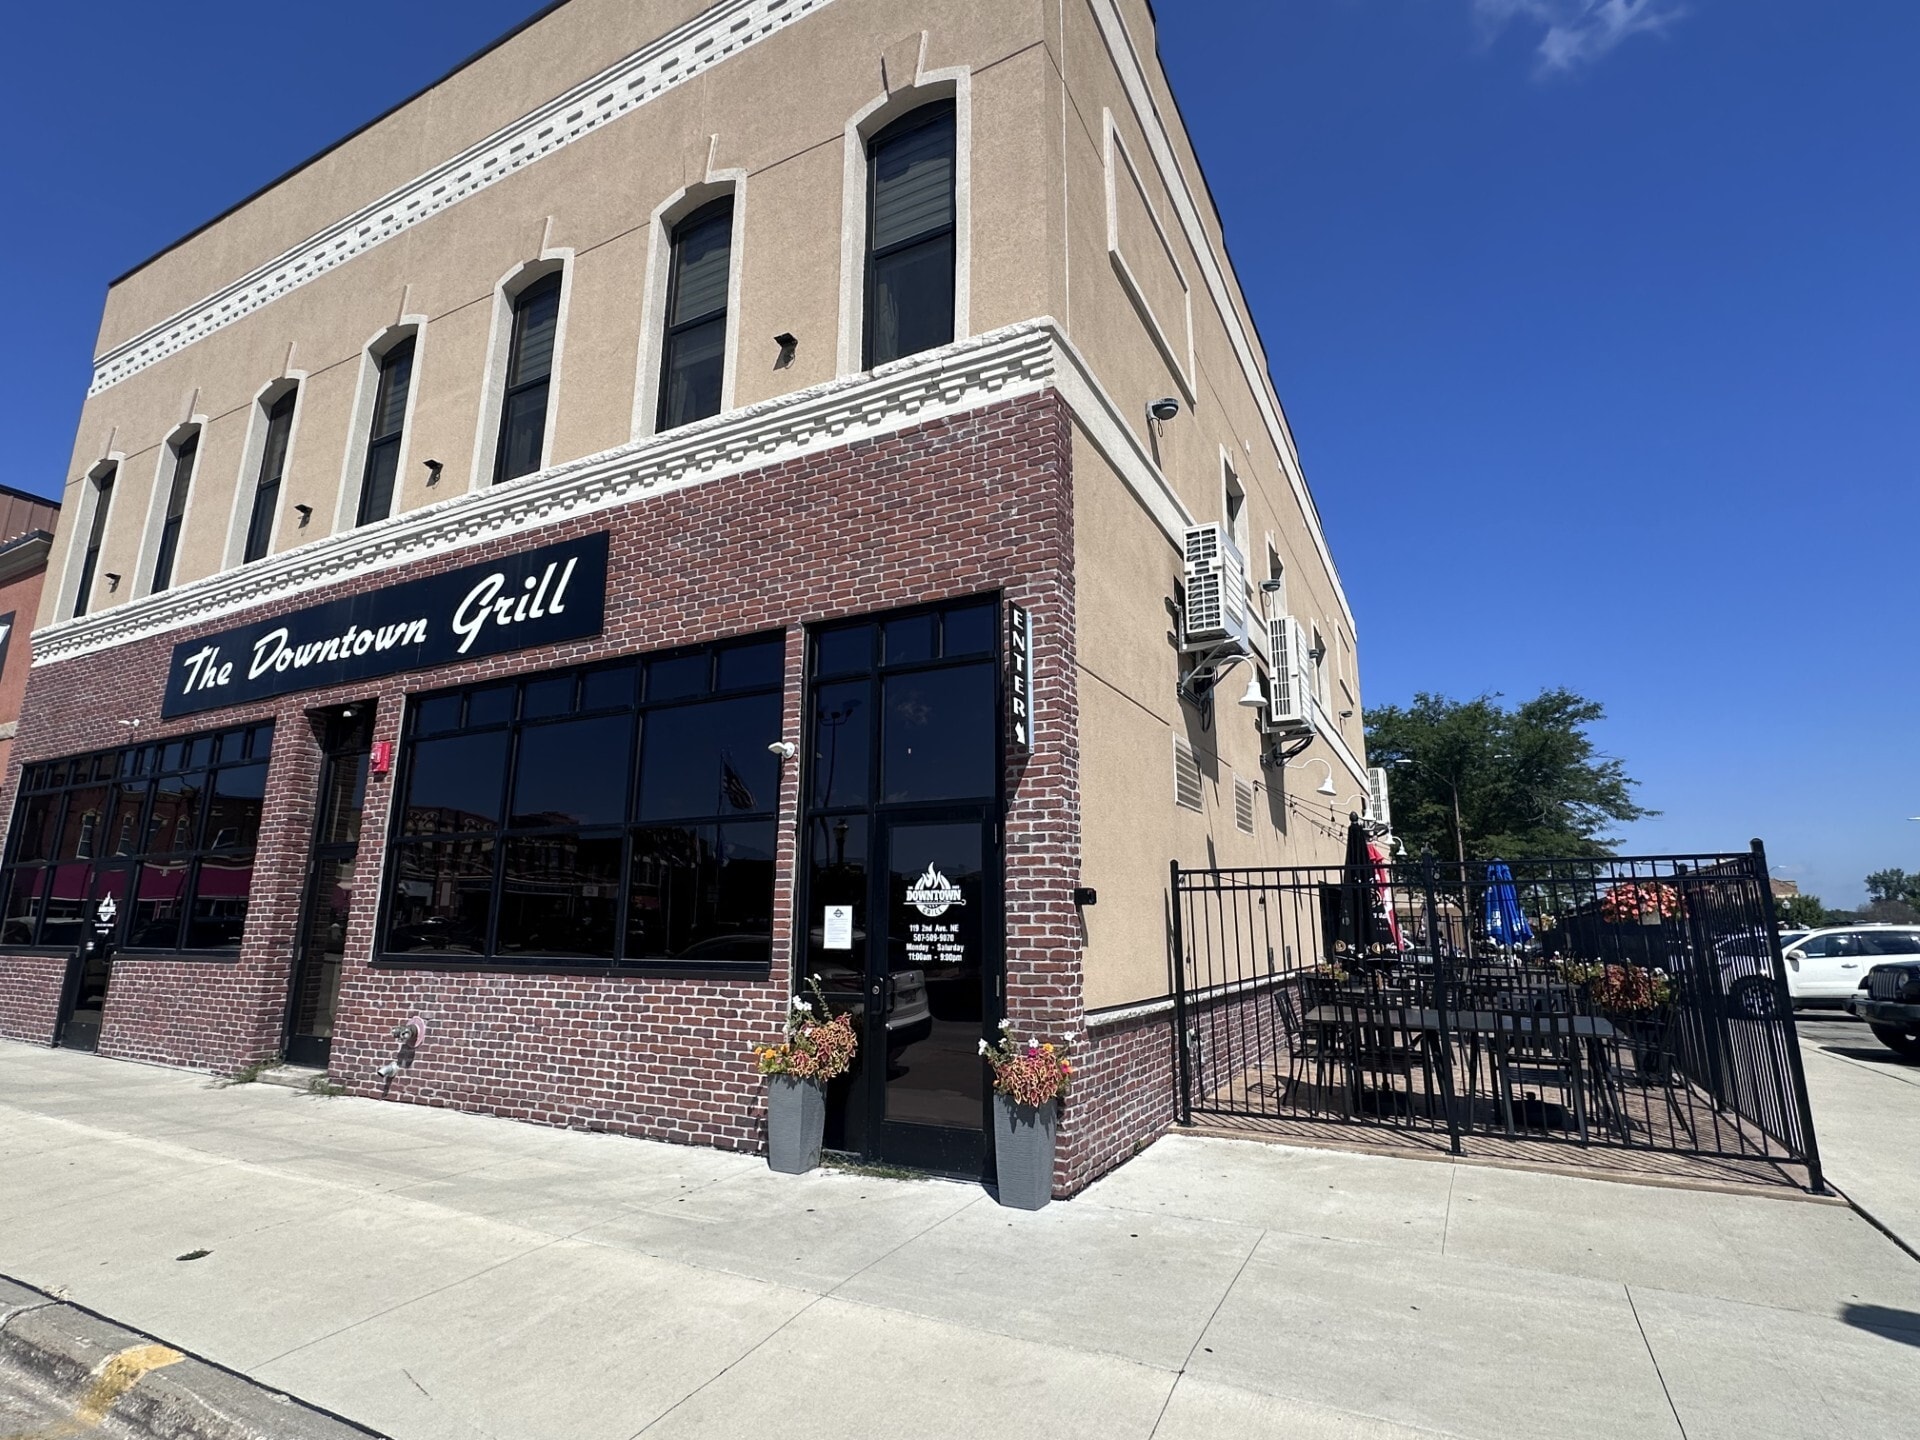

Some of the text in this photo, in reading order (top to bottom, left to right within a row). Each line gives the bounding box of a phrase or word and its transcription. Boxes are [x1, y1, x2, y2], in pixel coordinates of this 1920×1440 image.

[183, 557, 578, 695] The Downtown Grill
[1012, 608, 1026, 718] ENTER
[906, 889, 961, 901] DOWNTOWN
[922, 907, 943, 915] GRILL
[909, 924, 919, 932] 119
[921, 924, 932, 932] 2nd
[950, 924, 960, 932] NE
[906, 943, 929, 952] Monday
[937, 943, 964, 953] Saturday
[908, 952, 932, 961] 11:00am
